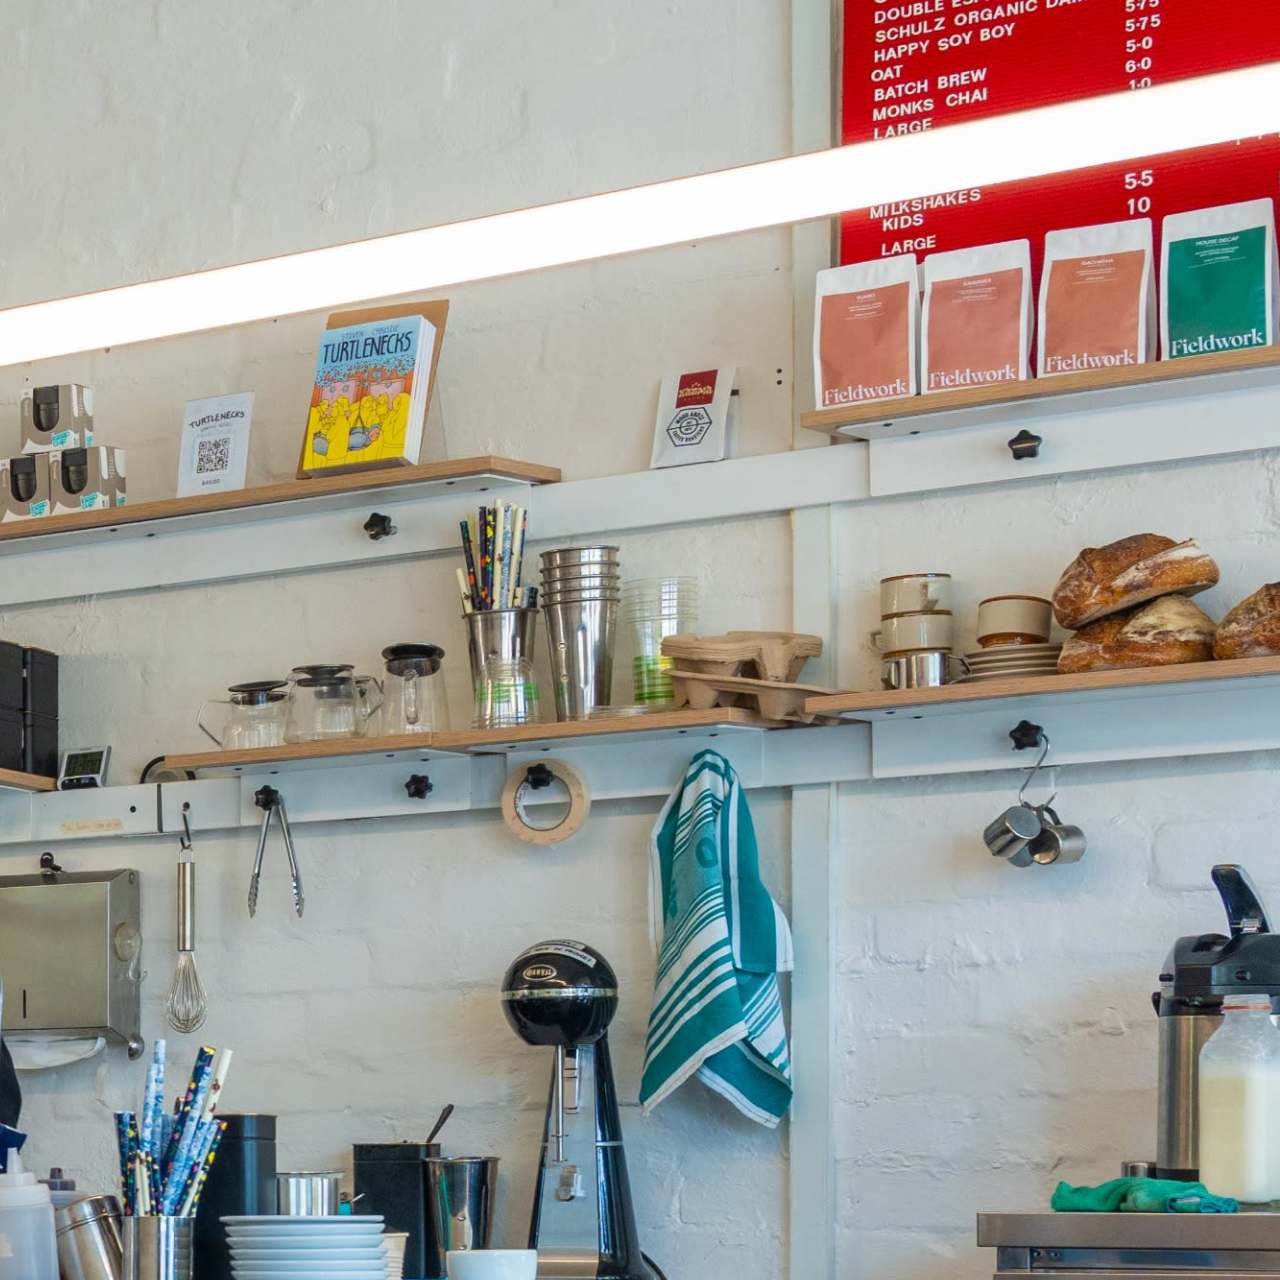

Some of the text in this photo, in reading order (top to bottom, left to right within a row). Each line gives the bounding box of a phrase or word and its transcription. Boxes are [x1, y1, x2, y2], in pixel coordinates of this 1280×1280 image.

[874, 0, 944, 24] DOUBLE
[875, 17, 946, 43] SCHULZ
[953, 0, 1038, 26] ORGANIC
[874, 40, 930, 63] HAPPY
[937, 31, 973, 51] SOY
[980, 22, 1016, 42] BOY
[870, 64, 903, 82] OAT
[874, 79, 928, 102] BATCH
[937, 67, 988, 90] BREW
[872, 98, 934, 121] MONKS
[945, 87, 988, 107] CHAI
[873, 118, 933, 140] LARGE
[869, 188, 981, 220] MILKSHAKES
[882, 196, 1151, 232] KIDS 10
[880, 235, 936, 256] LARGE
[322, 330, 413, 364] TURTLENECKS
[1171, 327, 1264, 357] Fieldwork
[1045, 349, 1135, 373] Fieldwork
[929, 364, 1017, 388] Fieldwork
[823, 378, 907, 405] Fieldwork
[188, 410, 245, 429] TURTLENECKS
